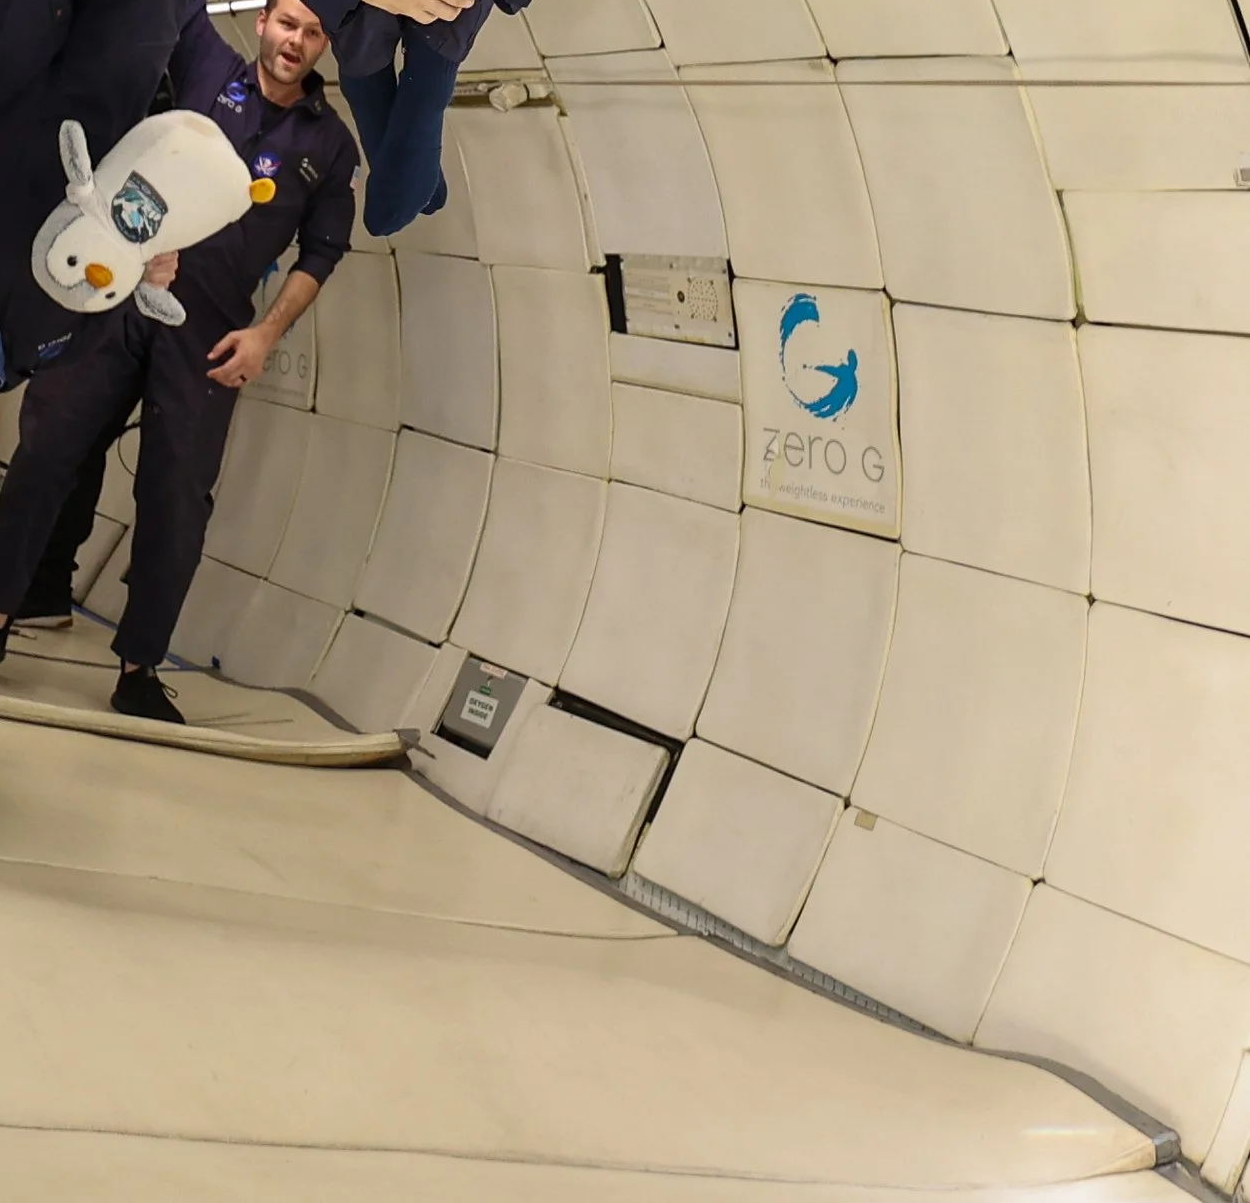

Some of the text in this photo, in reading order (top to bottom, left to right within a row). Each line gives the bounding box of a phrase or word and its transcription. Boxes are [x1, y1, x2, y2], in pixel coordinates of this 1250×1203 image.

[262, 350, 309, 379] ero G
[763, 427, 884, 483] zero G
[779, 483, 828, 502] weightless
[831, 493, 886, 514] experience
